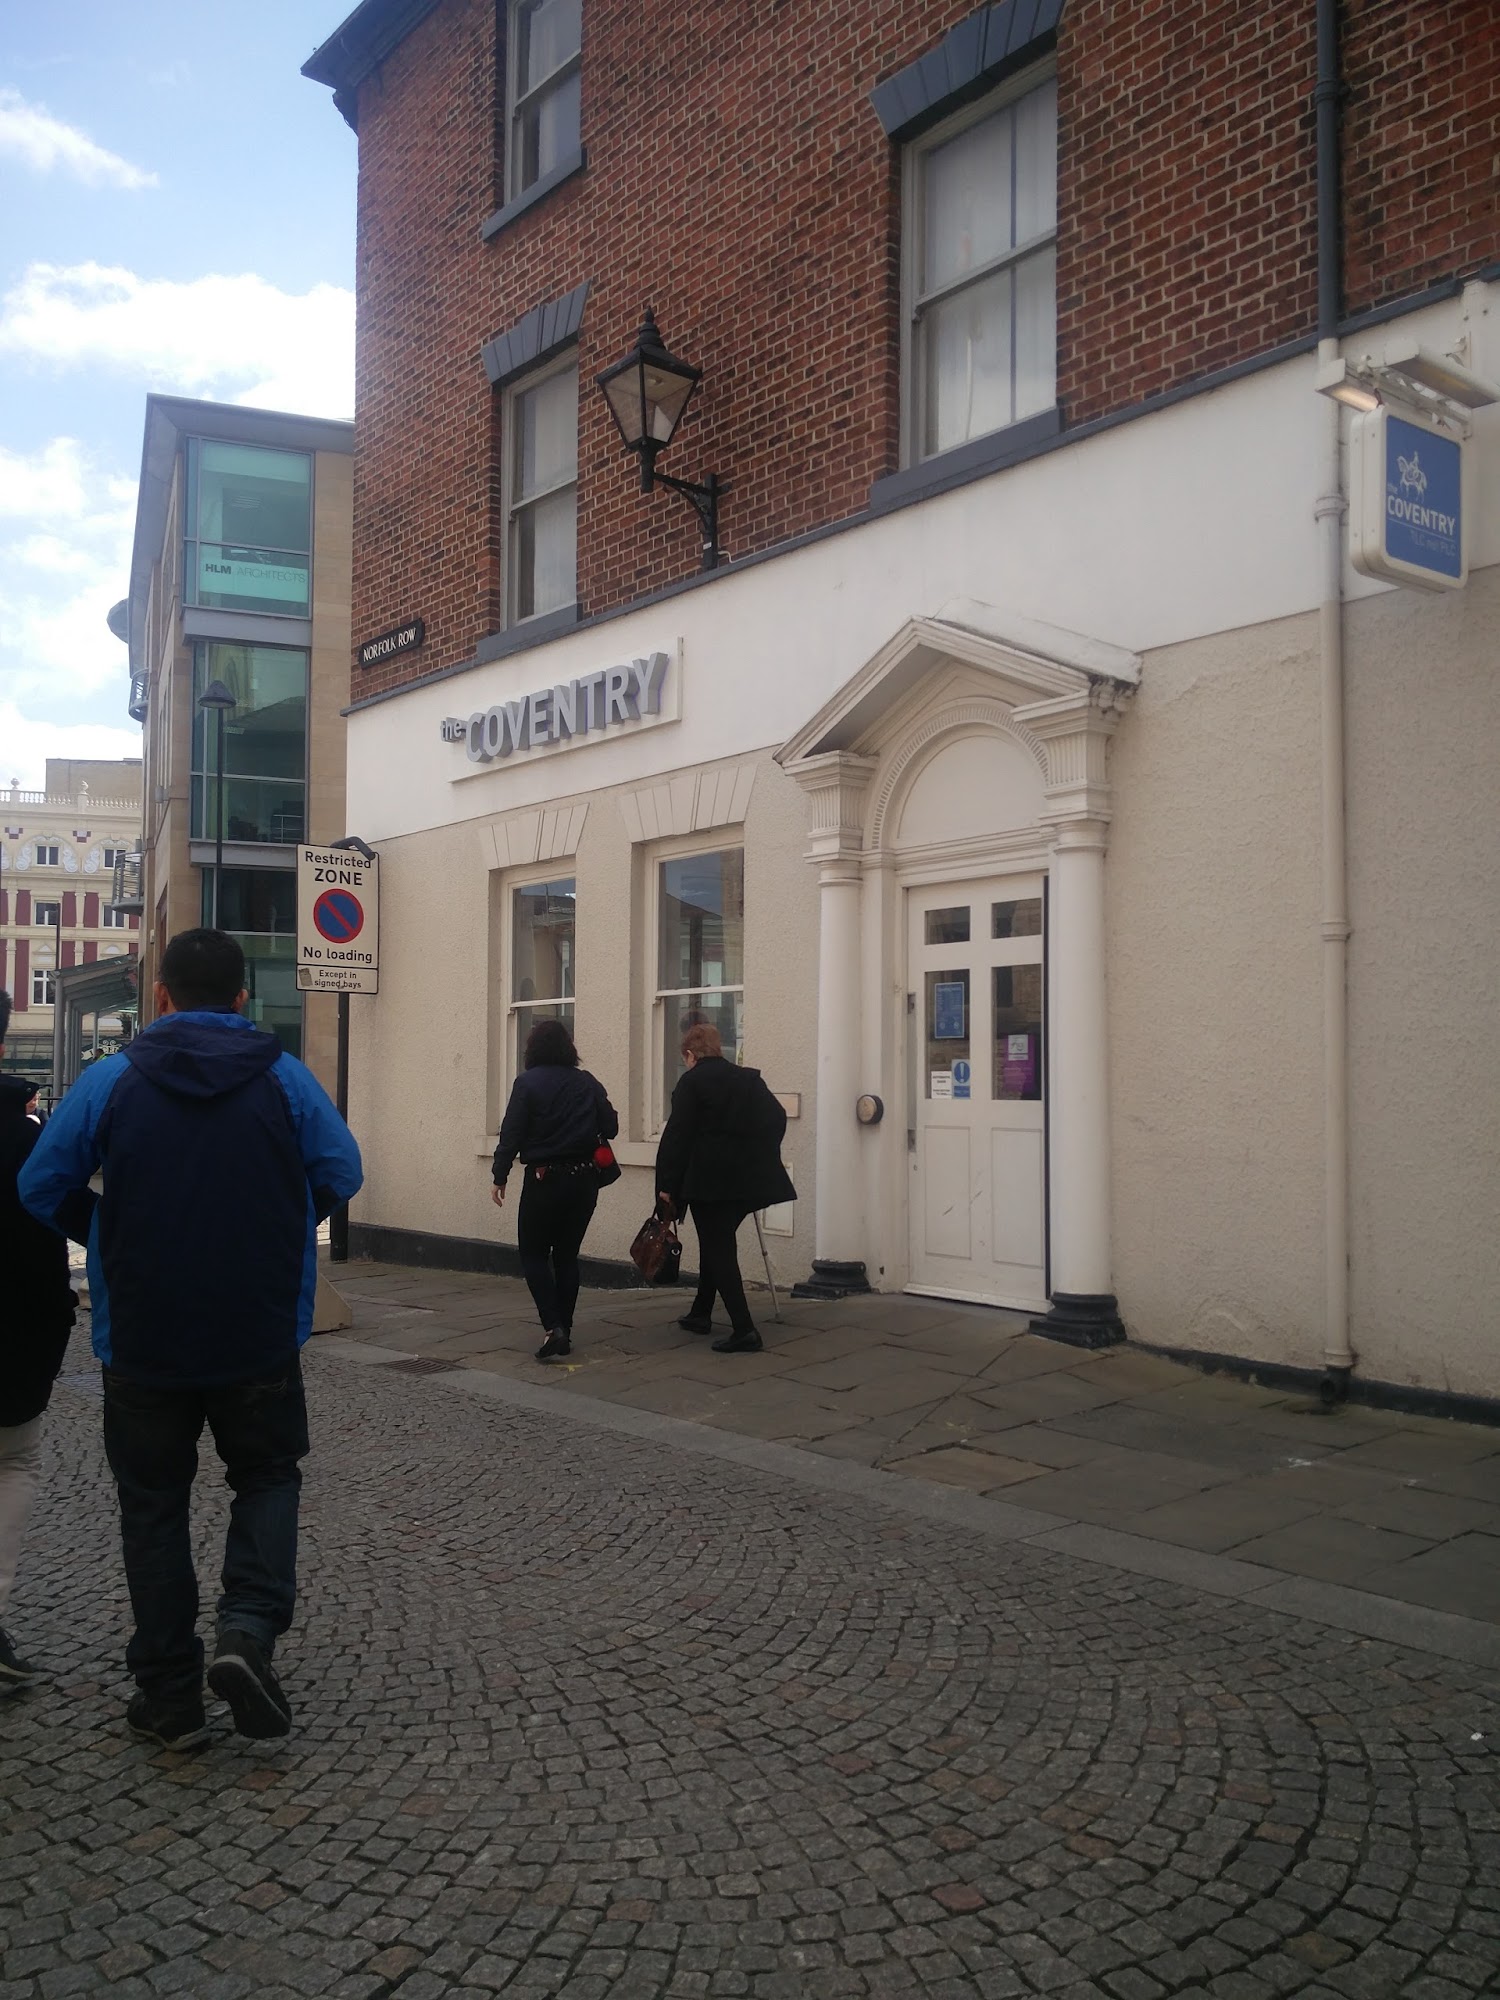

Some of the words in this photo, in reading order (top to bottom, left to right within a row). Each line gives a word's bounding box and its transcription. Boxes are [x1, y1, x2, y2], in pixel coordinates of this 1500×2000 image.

[1387, 495, 1455, 536] COVENTRY
[205, 563, 232, 575] HLM
[237, 567, 306, 583] ARCHITECTS
[363, 636, 397, 662] NORFOLK
[398, 627, 417, 648] ROW
[440, 717, 465, 743] the
[466, 652, 669, 763] COVENTRY
[305, 851, 371, 868] Restricted
[314, 868, 363, 886] ZONE
[303, 946, 322, 959] No
[327, 948, 372, 963] loading
[319, 969, 347, 980] Except
[349, 971, 357, 979] in
[314, 979, 341, 990] signed
[343, 980, 362, 989] bays
